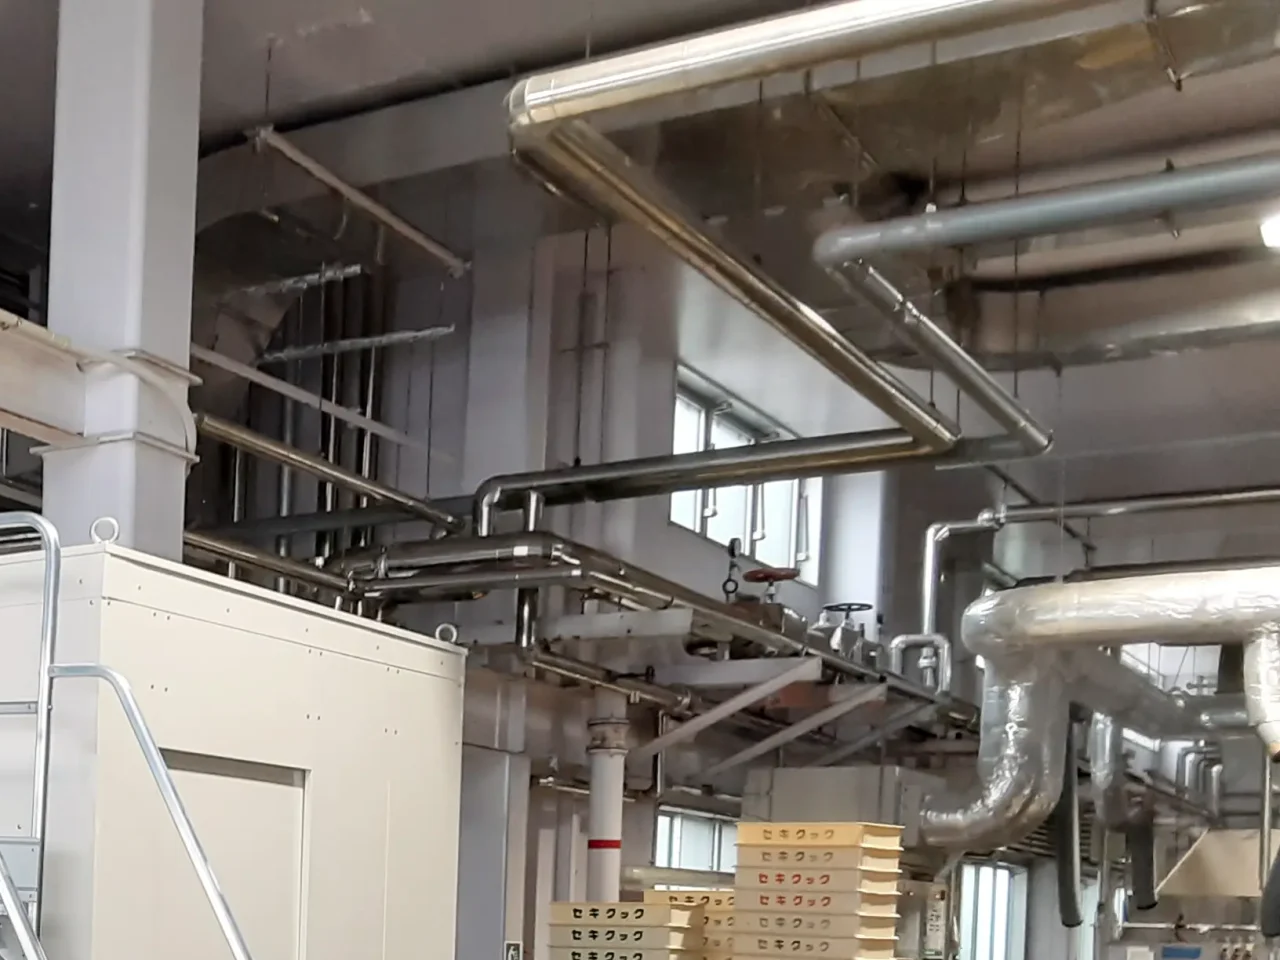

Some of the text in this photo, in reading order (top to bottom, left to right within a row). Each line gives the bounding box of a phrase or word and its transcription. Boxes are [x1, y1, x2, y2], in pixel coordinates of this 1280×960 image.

[764, 829, 834, 840] セキクック
[759, 873, 830, 885] セキクック
[760, 895, 831, 906] セキクック
[573, 908, 644, 919] セキクック
[572, 930, 643, 941] セキクック
[758, 939, 830, 951] セキクック
